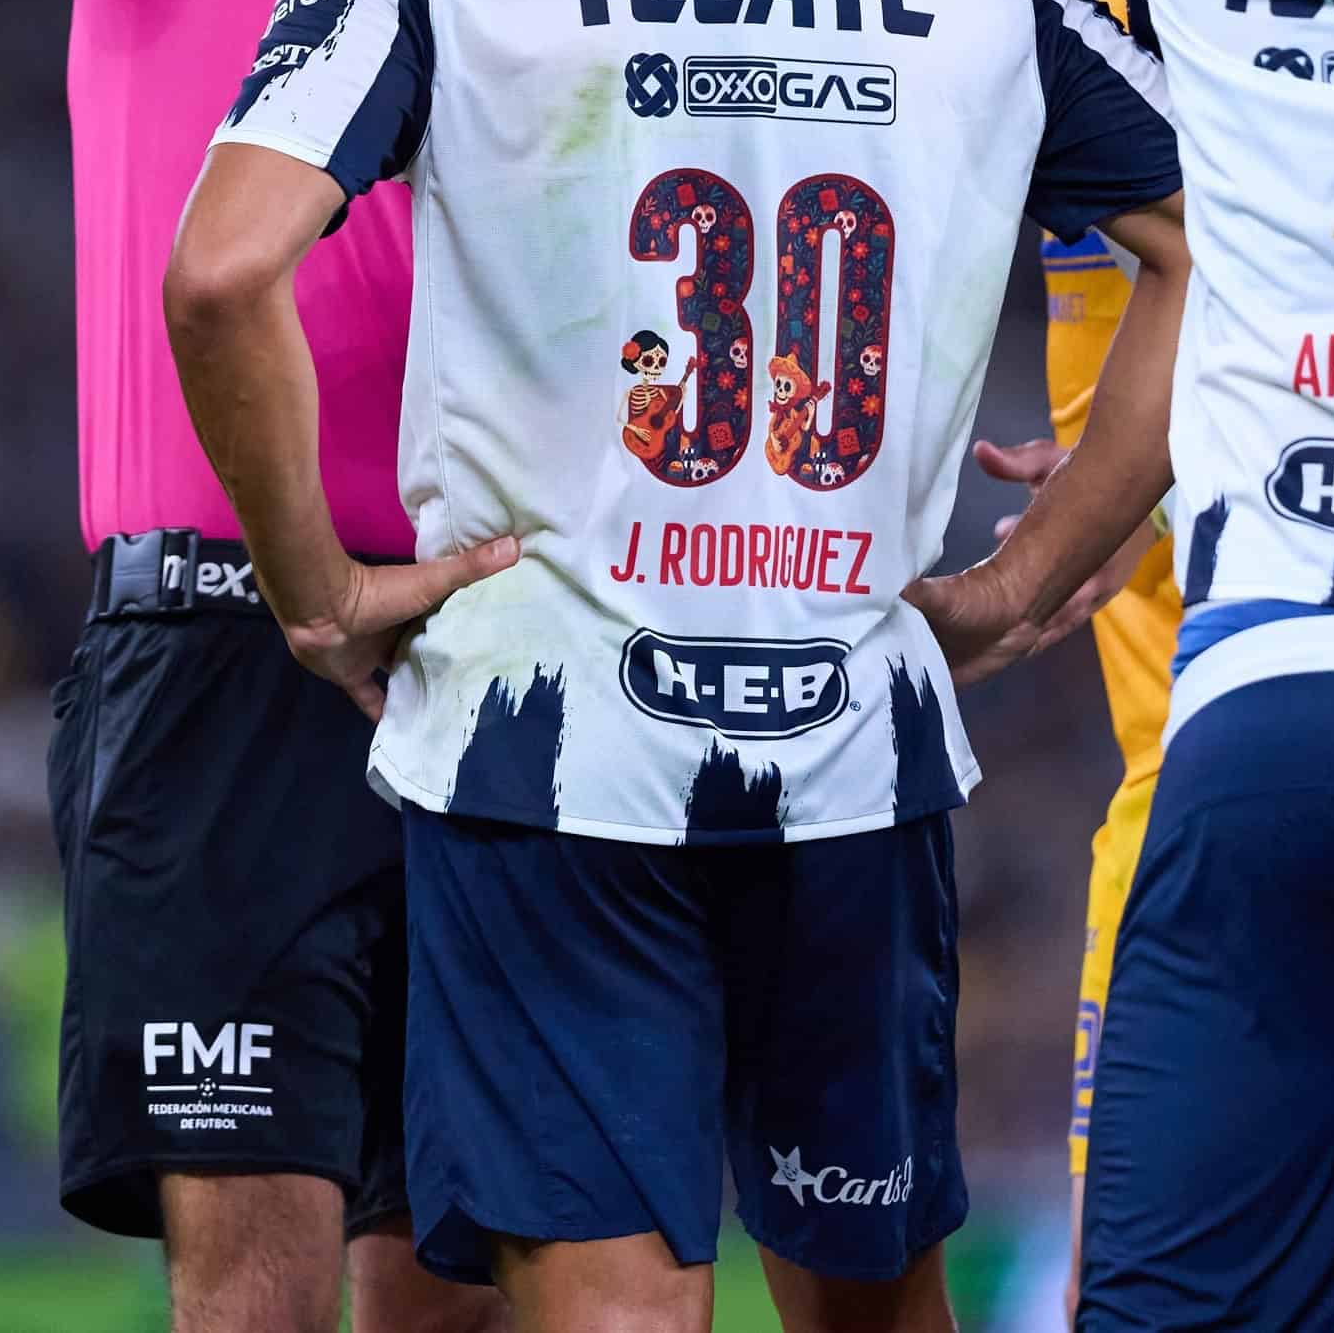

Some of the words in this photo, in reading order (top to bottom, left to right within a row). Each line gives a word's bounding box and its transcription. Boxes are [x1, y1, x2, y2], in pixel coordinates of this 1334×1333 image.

[623, 168, 895, 492] 30
[610, 521, 646, 584] J.
[659, 522, 873, 595] RODRIGUEZ
[652, 649, 835, 714] H-E-B
[143, 1022, 274, 1075] FMF
[148, 1100, 211, 1115] FEDERACIÓN
[213, 1103, 273, 1116] MEXICANA
[180, 1118, 194, 1129] DE
[195, 1118, 238, 1130] FUTBOL
